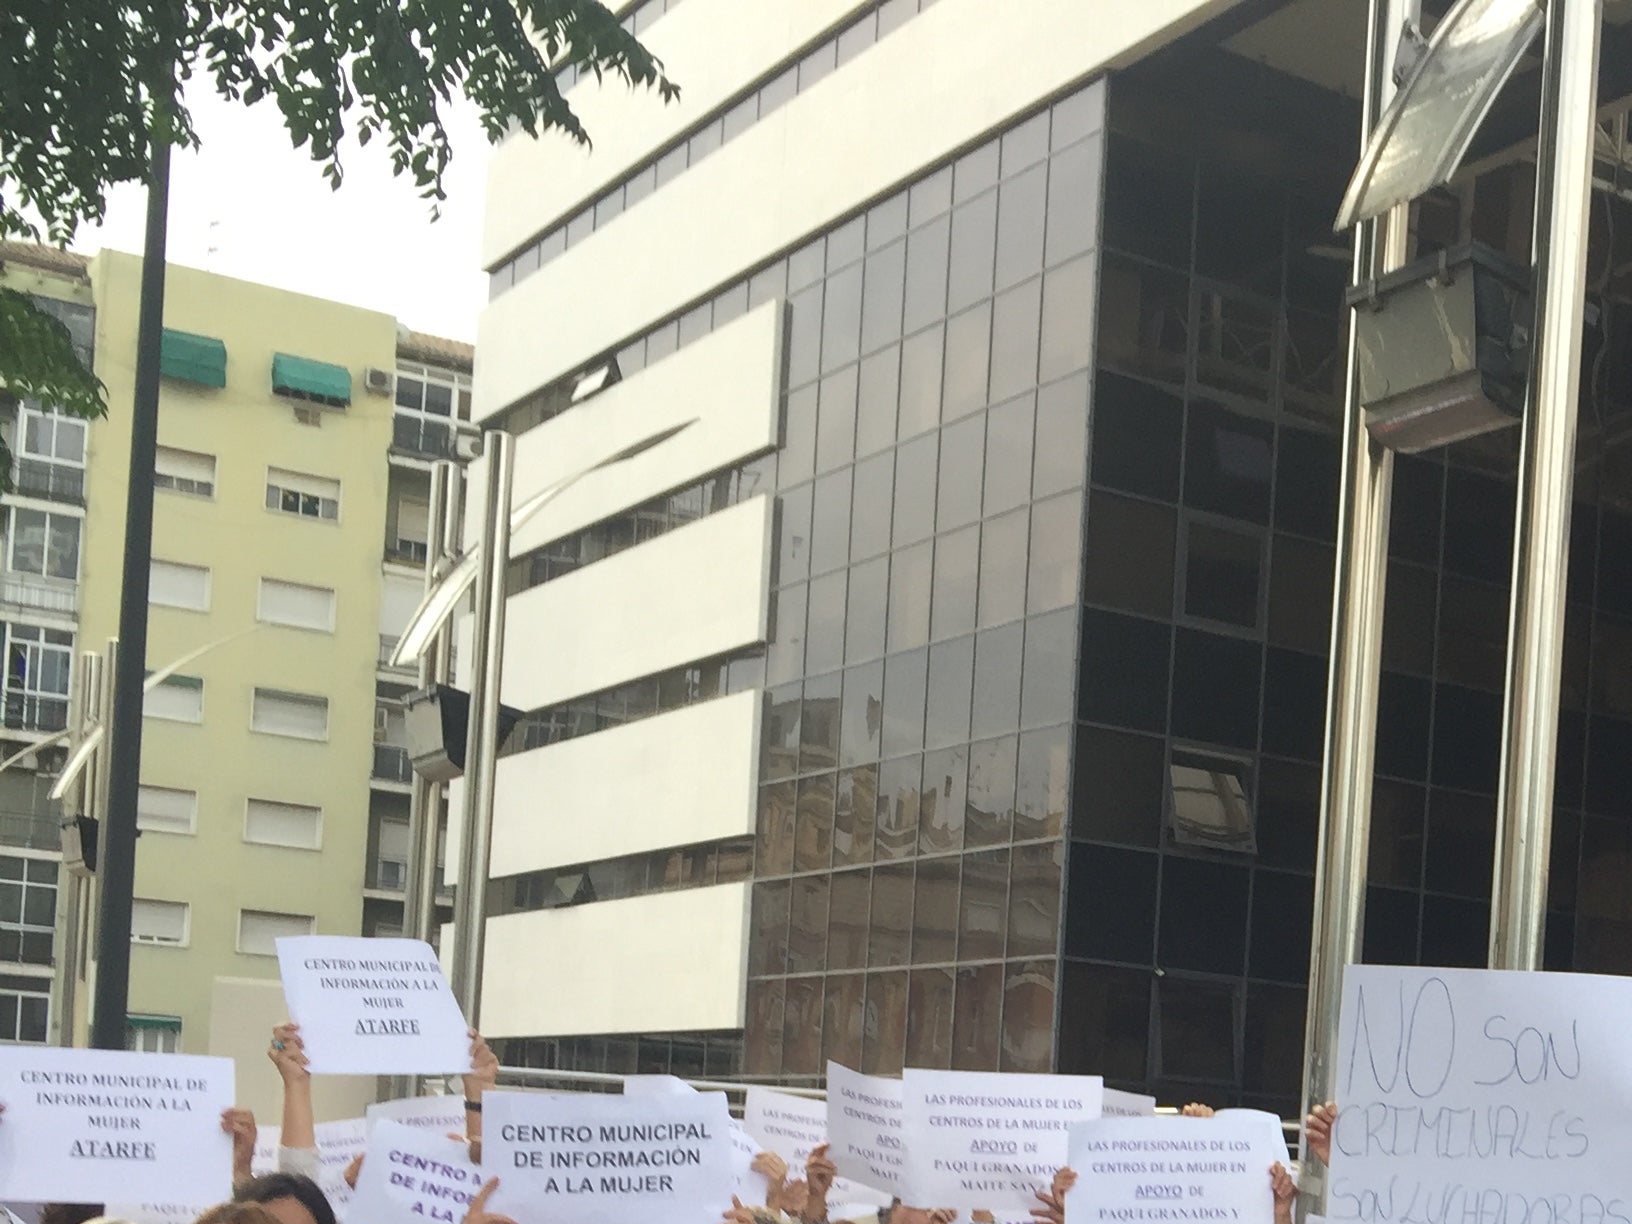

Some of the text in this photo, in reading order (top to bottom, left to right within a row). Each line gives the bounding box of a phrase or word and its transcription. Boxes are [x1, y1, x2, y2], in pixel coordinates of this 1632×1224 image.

[305, 959, 427, 973] CENTRO MUNICIPAL
[413, 980, 423, 991] A
[424, 980, 439, 991] LA
[363, 998, 404, 1010] MUJER
[355, 1019, 420, 1035] ATARFE
[1347, 977, 1581, 1098] NO SON
[21, 1070, 208, 1092] CENTRO MUNICIPAL DE
[157, 1098, 169, 1110] A
[172, 1098, 192, 1111] LA
[925, 1094, 1083, 1110] LAS PROFESIONALES DE LOS
[88, 1115, 141, 1130] MUJER
[929, 1116, 1061, 1131] CENTROS DE LA MUJER
[501, 1122, 712, 1143] CENTRO MUNICIPAL
[1335, 1102, 1590, 1160] CRIMINALES
[70, 1140, 156, 1160] ATARFE
[971, 1139, 1039, 1154] APOYO DE
[1087, 1140, 1251, 1152] LAS PROFESIONALES DE LOS
[514, 1145, 700, 1169] DE INFORMACIÓN
[389, 1150, 467, 1181] CENTRO
[934, 1159, 979, 1174] PAQUI
[1092, 1162, 1247, 1174] CENTROS DE LA MUJER EN
[390, 1172, 414, 1191] DE
[544, 1175, 673, 1194] A LA MUJER
[960, 1179, 1004, 1192] MAITE
[1135, 1184, 1204, 1199] APOYO DE
[411, 1201, 454, 1224] A LA
[1100, 1207, 1240, 1221] PAQUI GRANADOS Y
